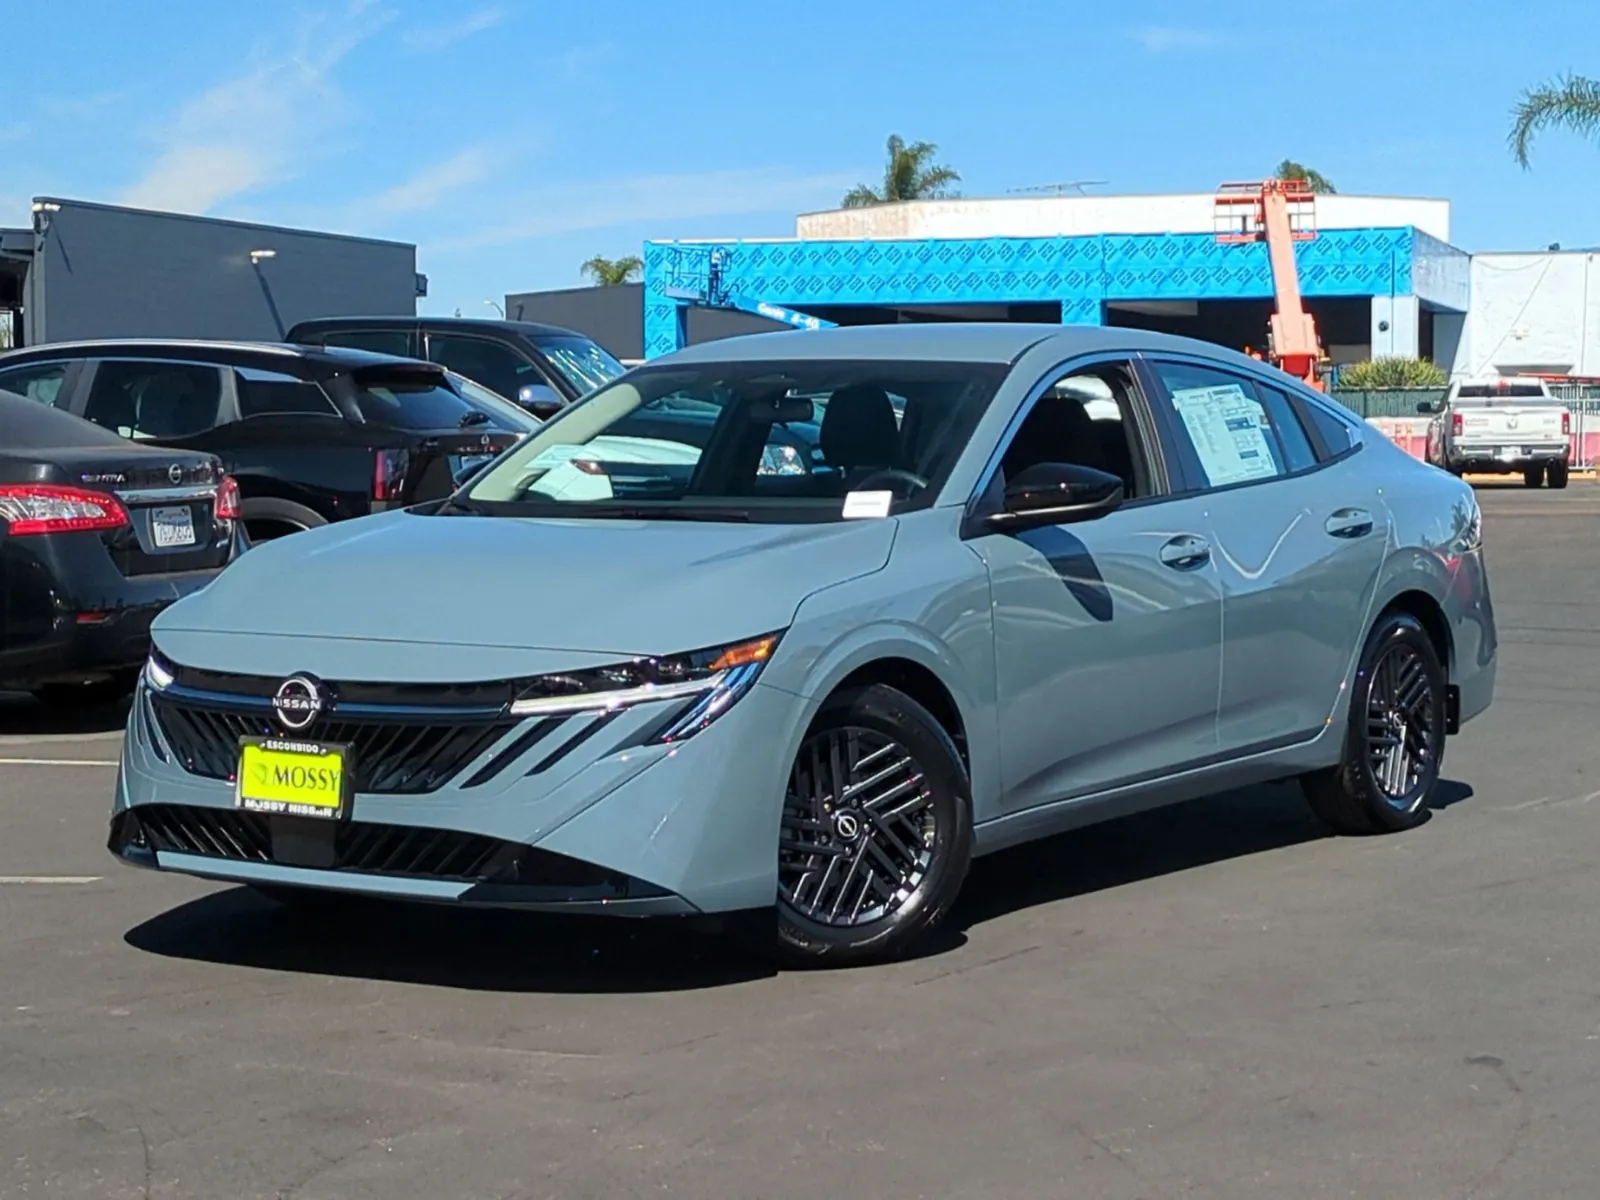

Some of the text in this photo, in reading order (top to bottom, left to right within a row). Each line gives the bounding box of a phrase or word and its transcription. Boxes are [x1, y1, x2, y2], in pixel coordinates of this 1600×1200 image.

[272, 697, 320, 709] NISSAN
[266, 740, 319, 753] ESCONDIDO
[273, 764, 340, 792] MOSSY
